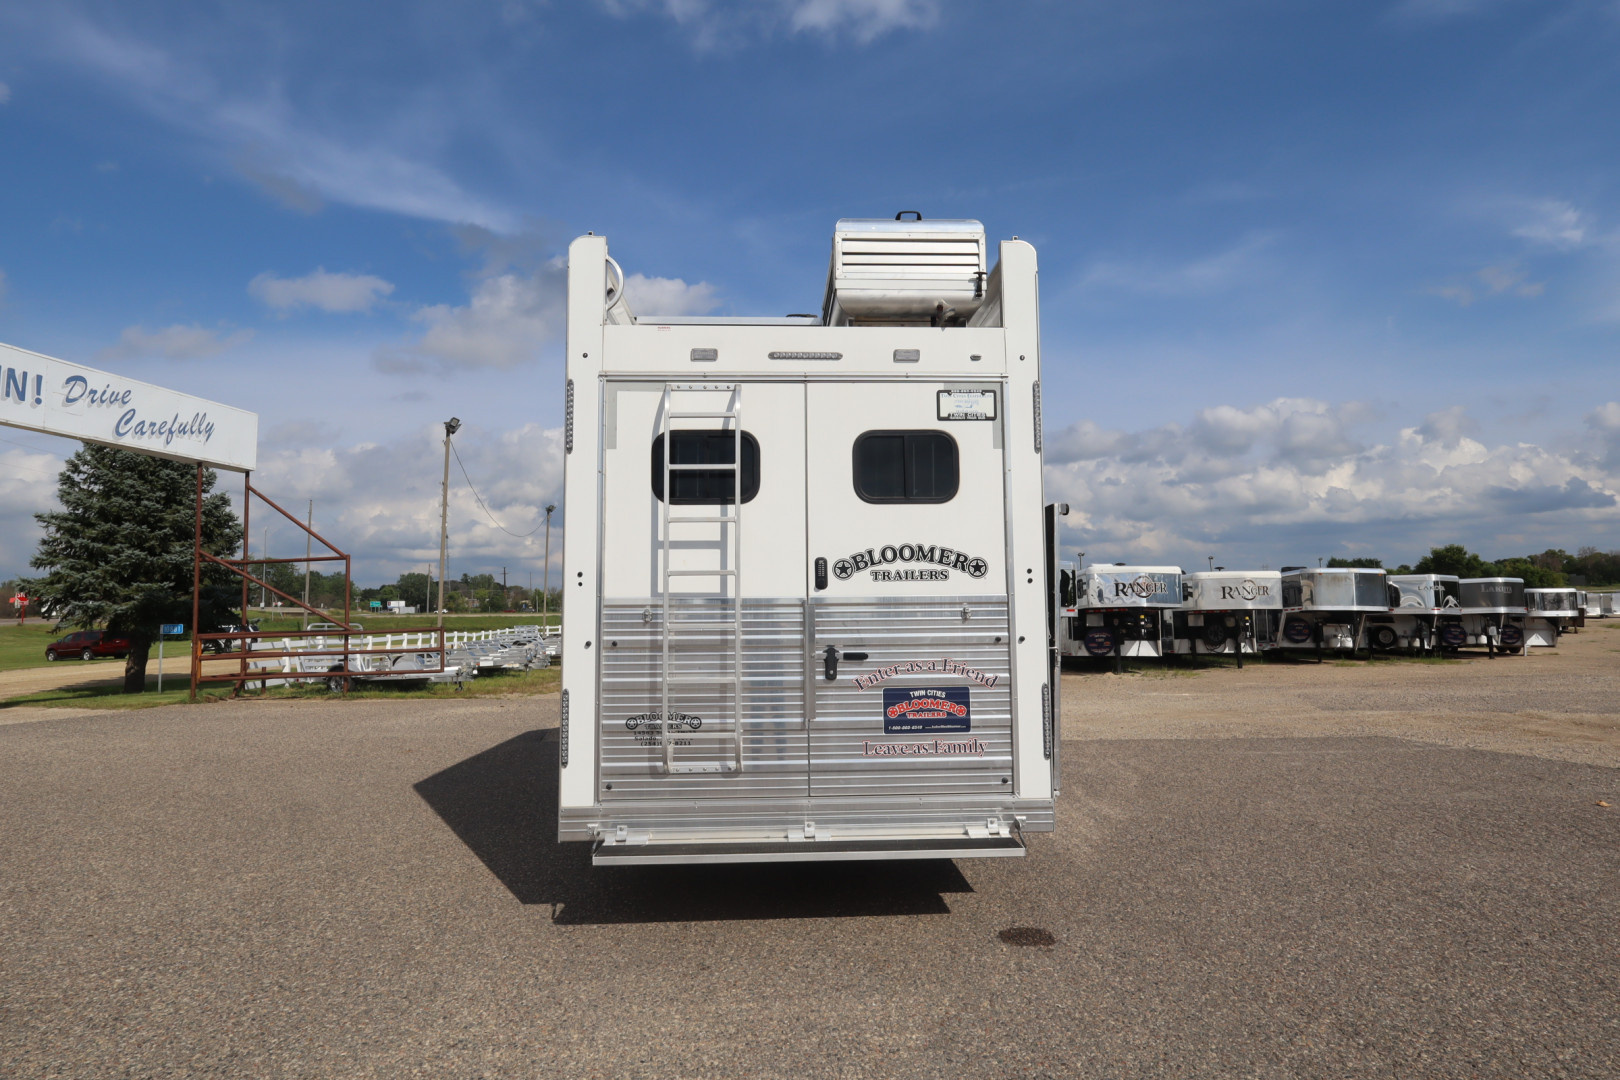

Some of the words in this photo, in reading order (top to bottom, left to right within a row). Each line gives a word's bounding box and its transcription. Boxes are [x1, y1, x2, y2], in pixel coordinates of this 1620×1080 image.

[65, 375, 132, 405] Drive
[114, 408, 215, 445] Carefully
[850, 543, 970, 573] BLOOMER
[870, 569, 949, 582] TRAILERS
[1113, 580, 1169, 597] RANGER
[1221, 584, 1270, 600] RANGER
[853, 664, 902, 692] Enter
[905, 660, 923, 673] as
[927, 661, 937, 672] a
[940, 657, 1000, 690] Friend
[909, 689, 926, 698] TWIN
[926, 689, 946, 698] CITIES
[896, 698, 957, 715] BLOOMER
[906, 711, 947, 719] TRAILERS
[863, 740, 909, 756] Leave
[912, 742, 929, 755] as
[932, 737, 988, 757] Family
